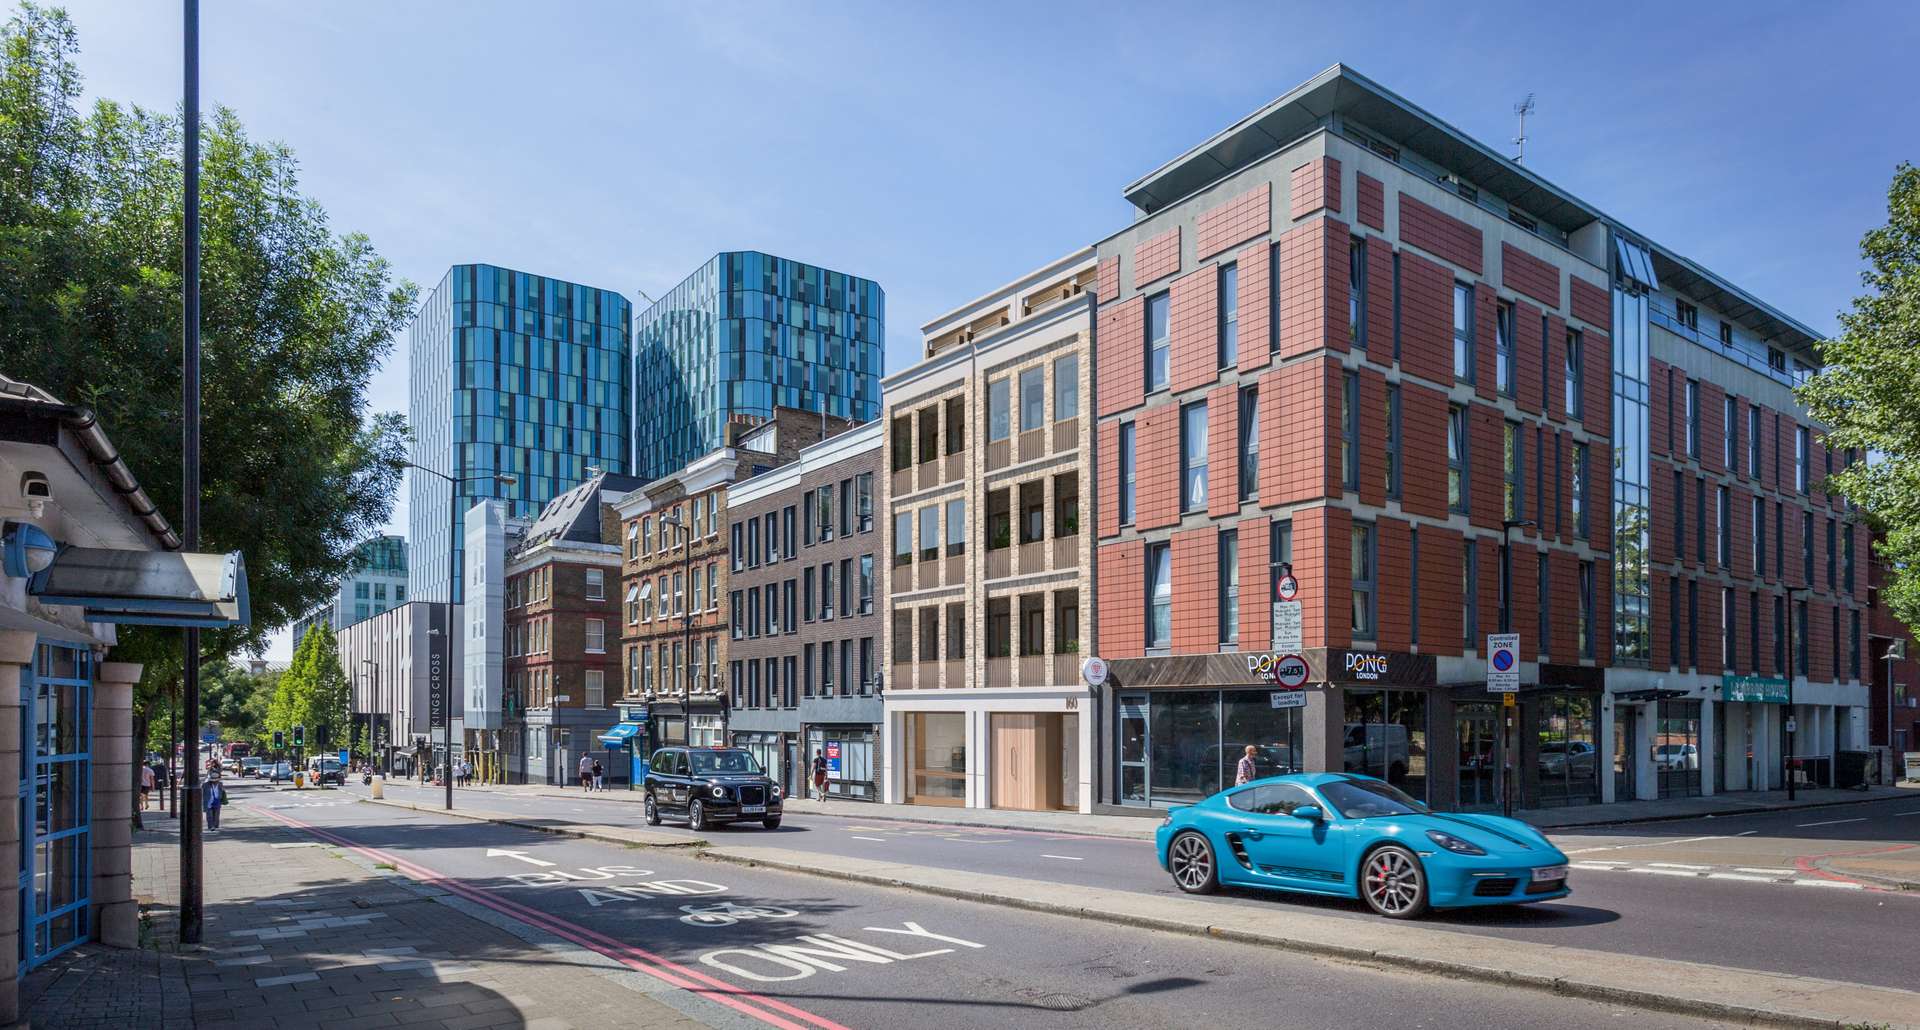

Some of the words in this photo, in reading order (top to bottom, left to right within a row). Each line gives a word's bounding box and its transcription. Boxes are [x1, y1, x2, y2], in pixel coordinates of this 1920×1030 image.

[431, 653, 441, 690] CROSS
[1345, 653, 1388, 673] PONG
[1356, 672, 1378, 680] LONDON
[431, 693, 441, 728] KINGS
[1065, 696, 1078, 710] 160
[492, 865, 655, 888] BUS
[577, 879, 729, 907] AND
[698, 921, 986, 982] ONLY
